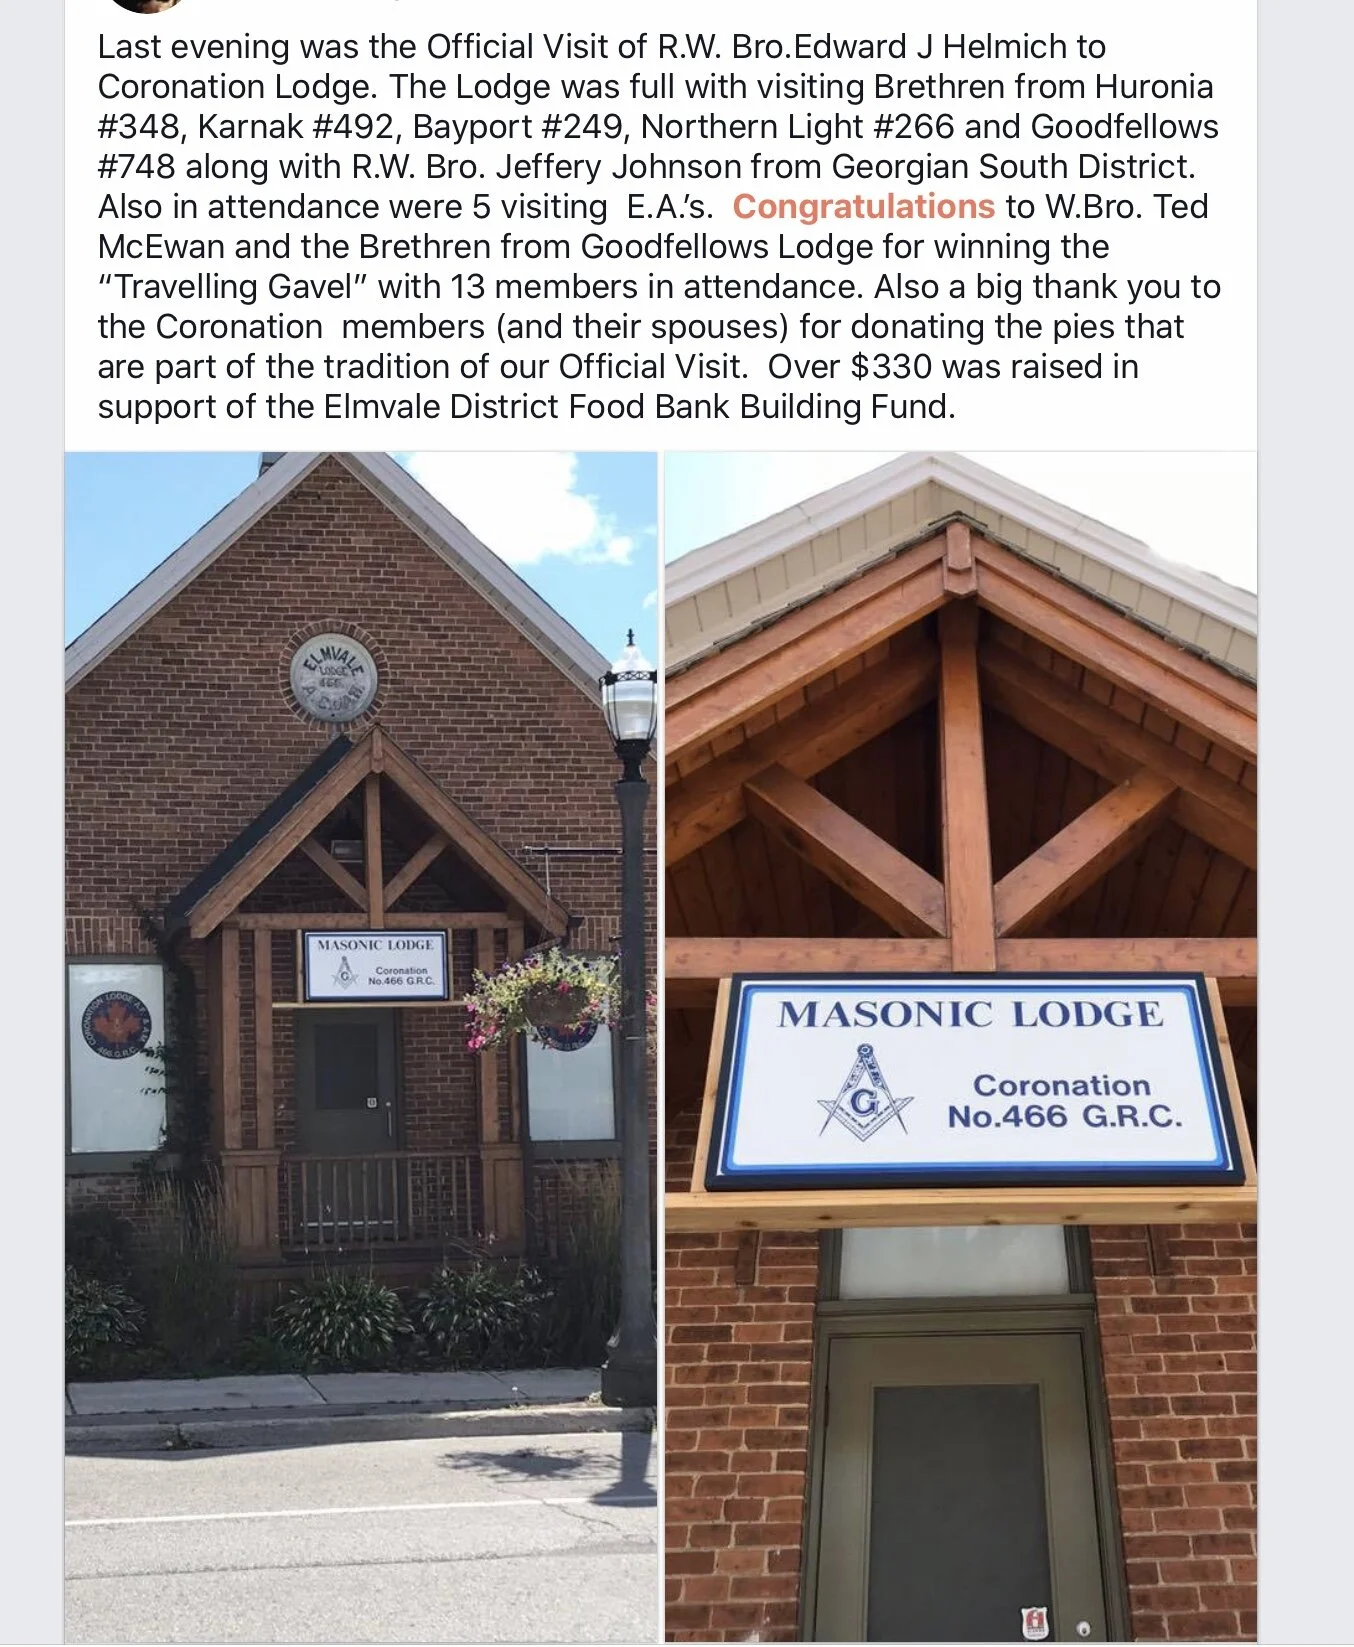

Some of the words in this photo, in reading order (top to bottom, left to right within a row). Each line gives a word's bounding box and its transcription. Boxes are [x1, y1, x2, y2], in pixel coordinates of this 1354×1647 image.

[303, 646, 364, 676] ELMVALE
[319, 666, 347, 676] LODGE
[318, 939, 383, 951] MASONIC
[388, 939, 434, 950] LODGE
[368, 976, 404, 985] No.466
[407, 976, 435, 985] G.R.C.
[375, 966, 428, 975] Coronation
[777, 999, 993, 1029] MASONIC
[1012, 999, 1164, 1028] LODGE
[973, 1074, 1151, 1097] Coronation
[849, 1089, 880, 1117] G
[948, 1104, 1067, 1129] No.466
[1083, 1104, 1183, 1129] G.R.C.
